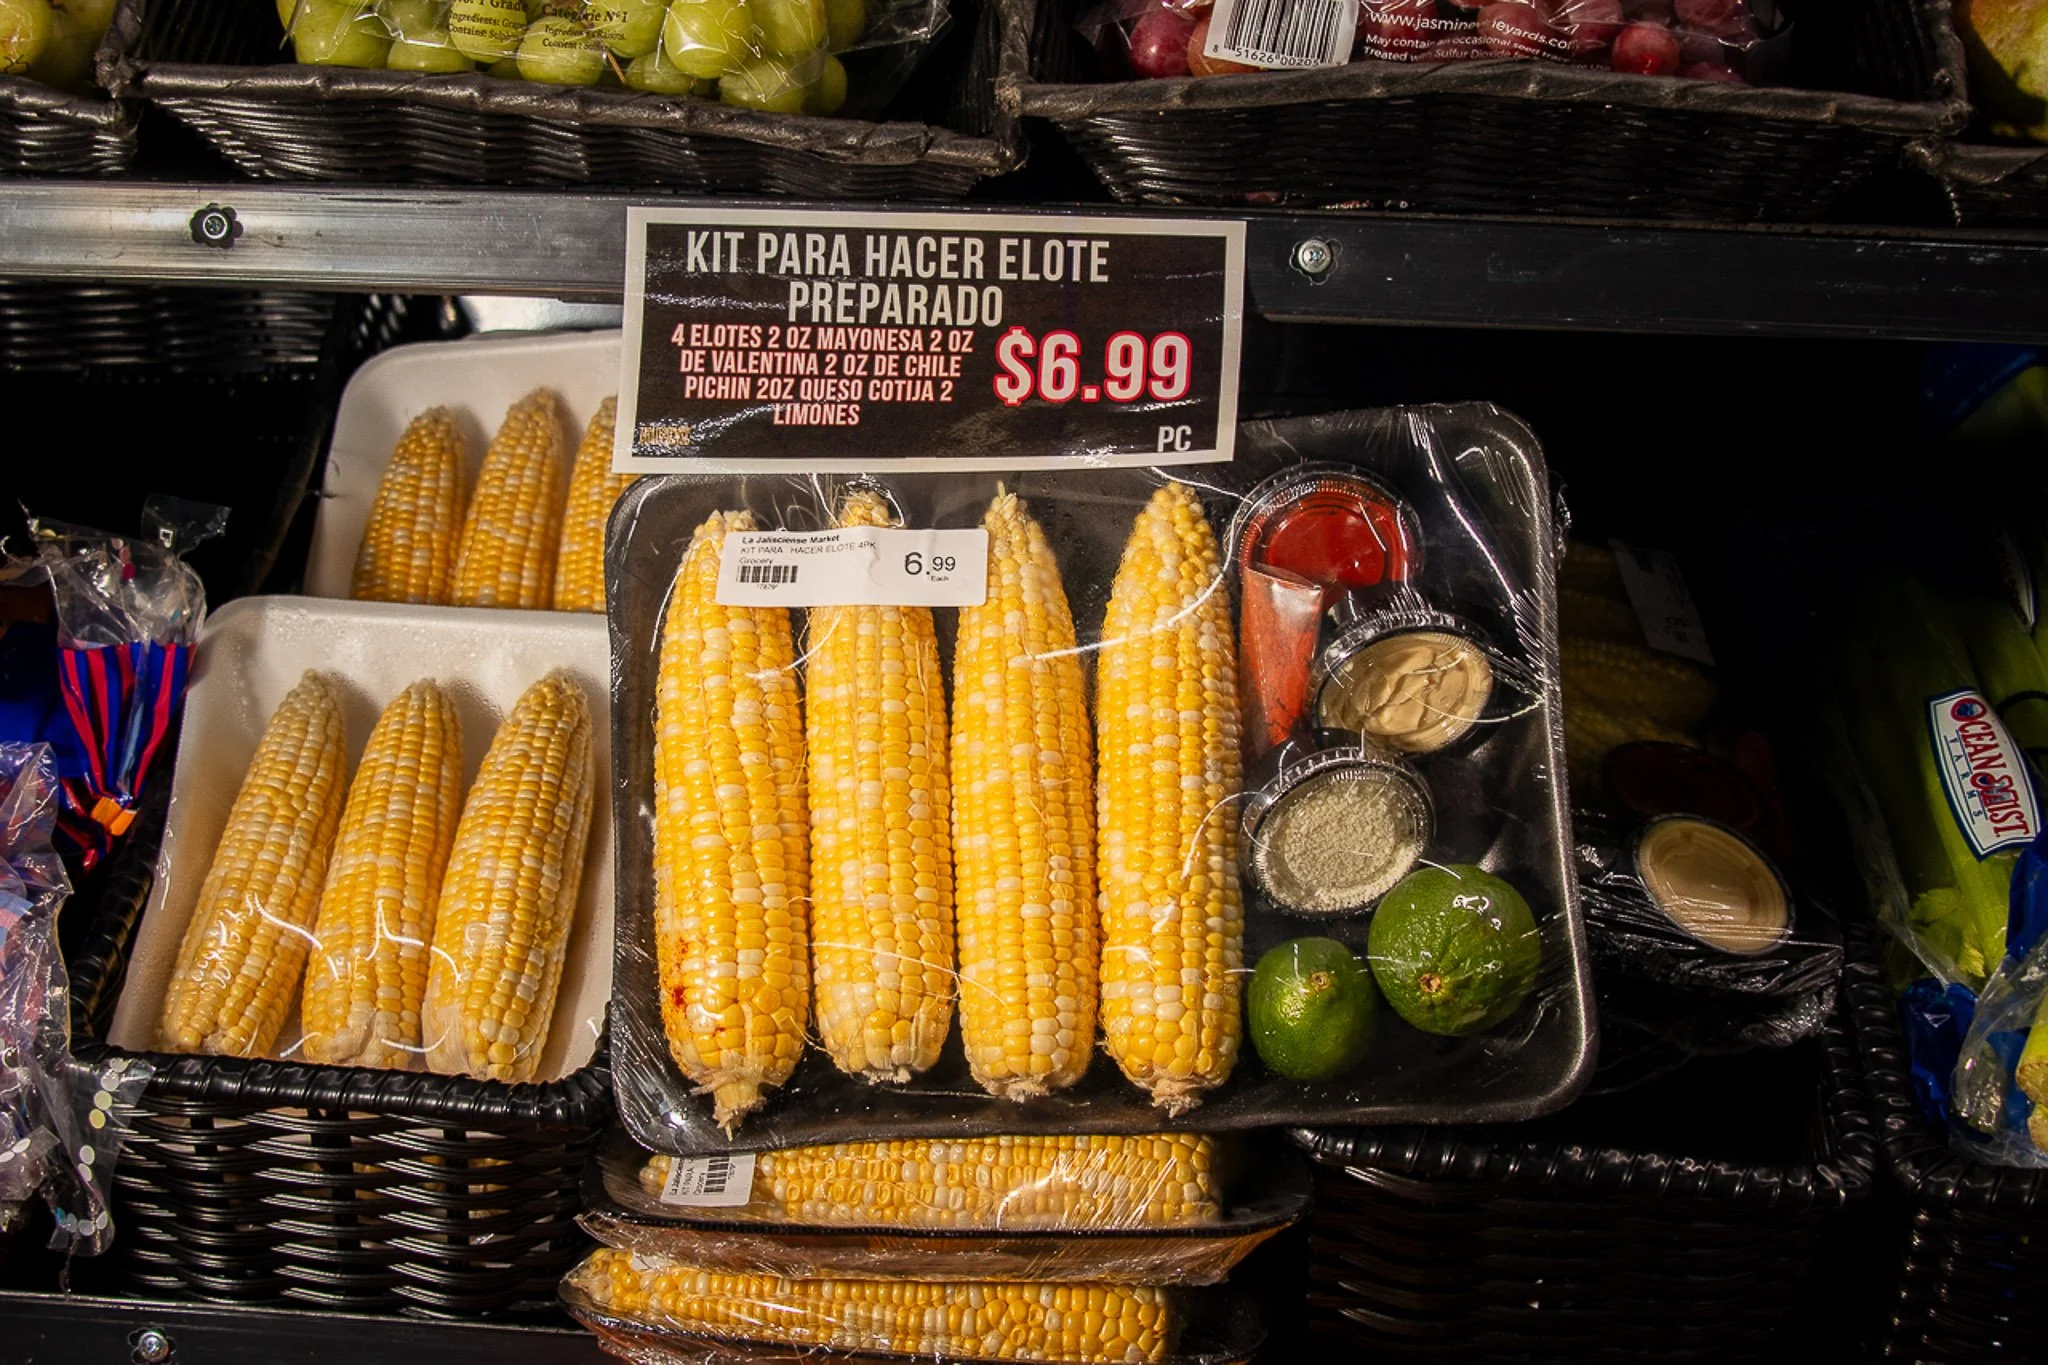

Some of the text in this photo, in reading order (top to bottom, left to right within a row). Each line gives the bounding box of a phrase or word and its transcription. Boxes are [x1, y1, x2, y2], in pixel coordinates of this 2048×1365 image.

[1365, 33, 1391, 47] May
[1452, 35, 1511, 47] occasional
[1212, 44, 1219, 53] 8
[1235, 47, 1275, 64] 51626
[1364, 46, 1408, 61] Treated
[1434, 48, 1467, 59] Sulfur
[686, 230, 1110, 283] KIT PARA HACER ELOTE
[788, 280, 1004, 327] PREPARADO
[671, 323, 974, 353] 4 ELOTES 2 OZ MAYONESA 2 OZ
[679, 350, 962, 378] DE VALENTINA 2 OZ DE CHILE
[993, 325, 1192, 407] $6.99
[684, 376, 953, 402] PICHIN 2OZ QUESO COTIJA 2
[773, 402, 860, 425] LIMONES
[1157, 425, 1192, 452] PC
[740, 541, 876, 554] KIT PARA HACER ELOTE 4PK
[810, 534, 840, 543] Market
[739, 556, 773, 565] Grocery
[905, 551, 956, 575] 6.99
[1950, 697, 2007, 771] OCEAN
